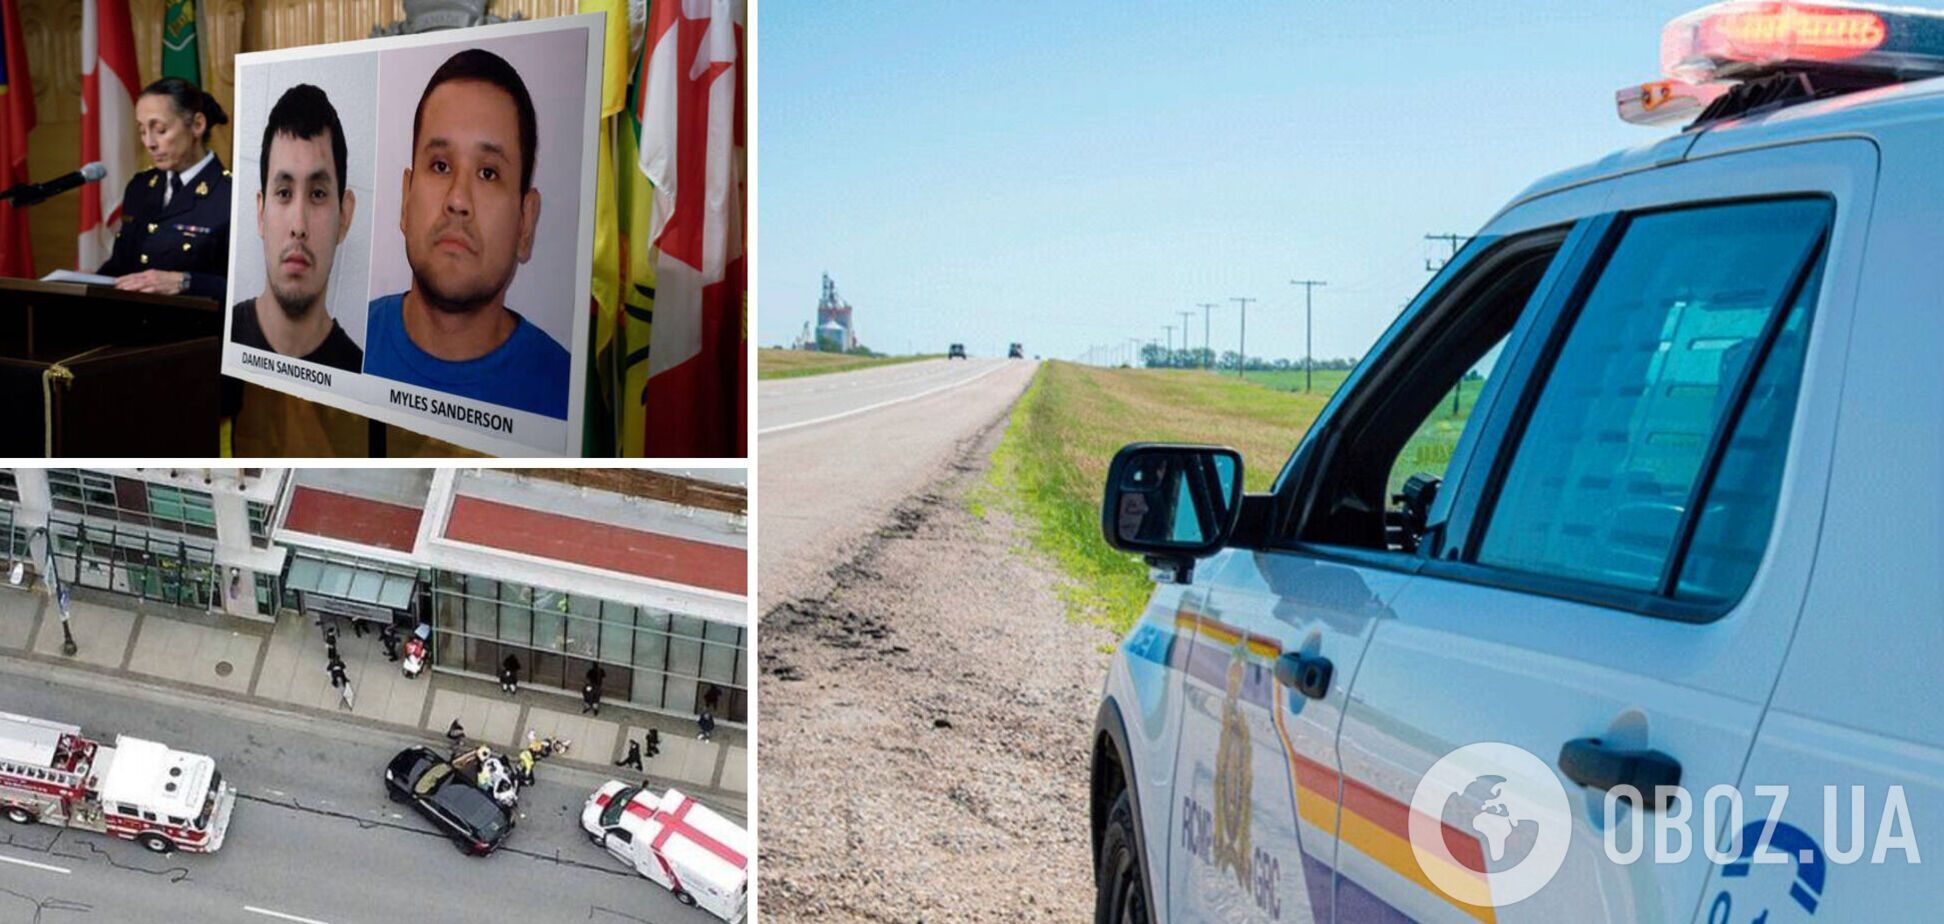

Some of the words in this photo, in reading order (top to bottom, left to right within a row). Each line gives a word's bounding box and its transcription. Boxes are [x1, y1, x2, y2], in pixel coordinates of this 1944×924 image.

[242, 352, 274, 371] DAMIEN
[276, 361, 332, 387] SANDERSON
[390, 389, 428, 412] MYLES
[430, 399, 513, 433] SANDERSON
[1254, 847, 1281, 921] GRC
